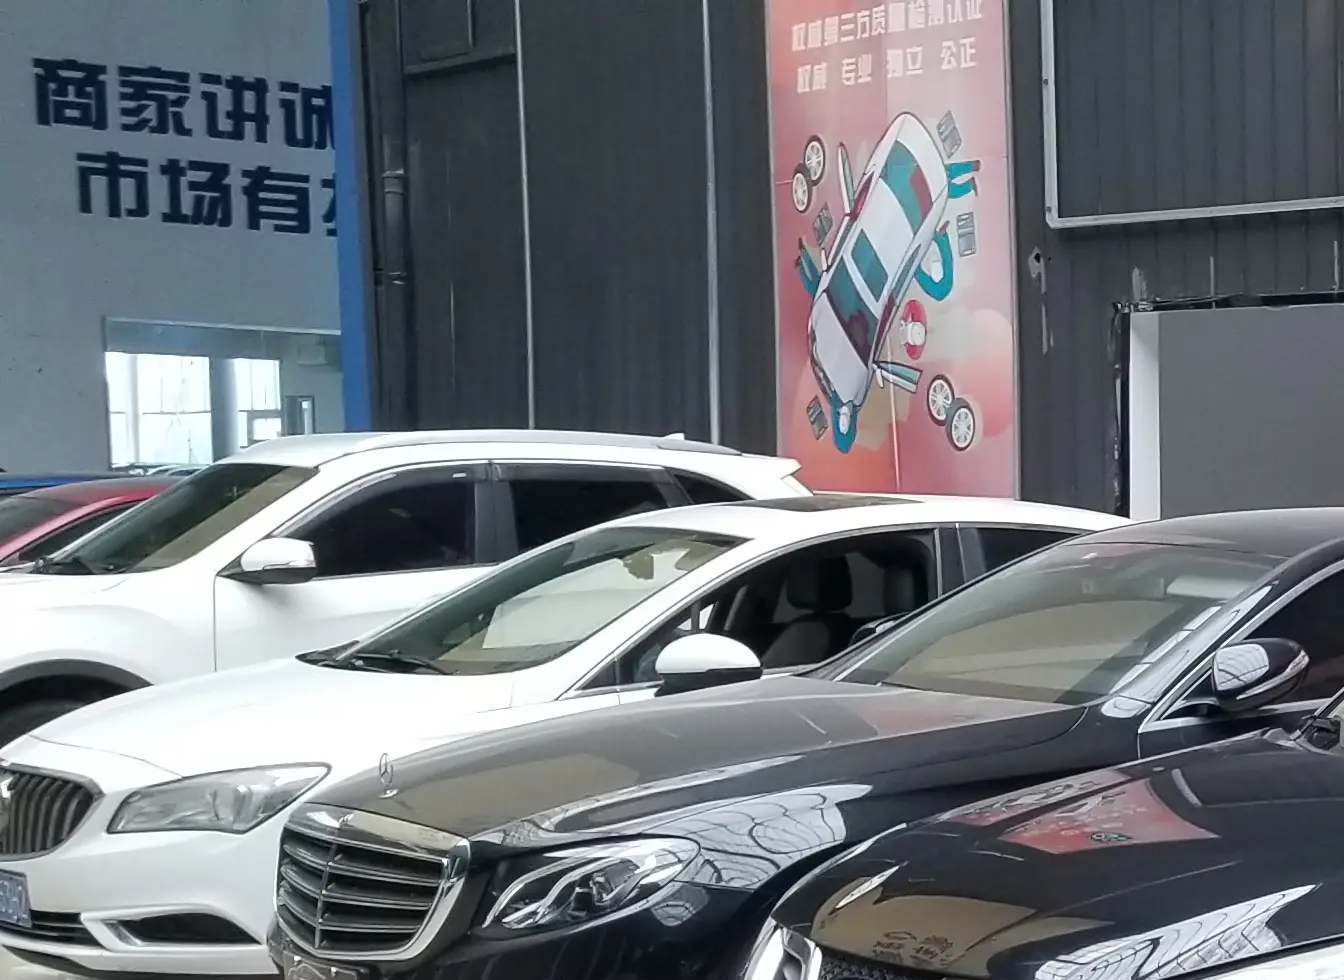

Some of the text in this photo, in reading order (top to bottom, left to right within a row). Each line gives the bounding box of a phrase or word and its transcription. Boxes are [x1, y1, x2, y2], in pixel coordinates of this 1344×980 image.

[841, 54, 872, 85] 专业
[886, 46, 923, 78] 独立
[940, 37, 977, 70] 公正
[32, 58, 336, 150] 商家讲诚
